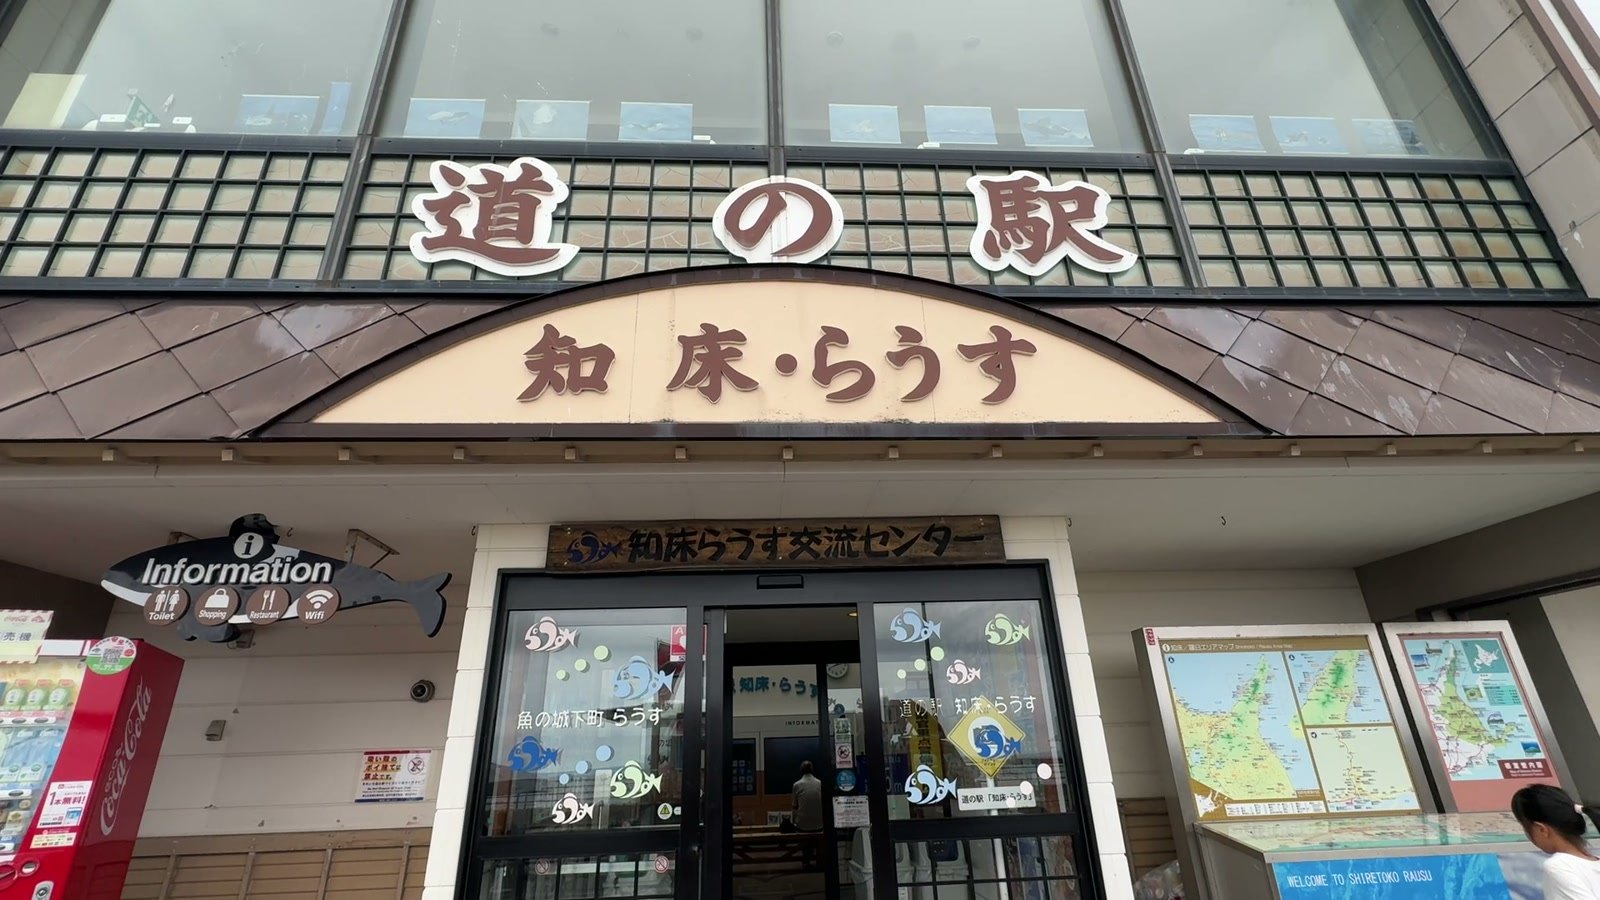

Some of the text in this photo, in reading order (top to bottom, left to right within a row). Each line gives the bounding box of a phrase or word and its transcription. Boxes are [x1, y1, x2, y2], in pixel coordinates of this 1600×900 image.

[421, 163, 1126, 265] 道の駅
[516, 323, 1038, 404] 知床・らうす
[627, 523, 985, 563] 知床らうす交流センター
[141, 557, 332, 584] Information
[149, 612, 175, 620] Toilet
[198, 609, 227, 619] Shopping
[249, 611, 280, 619] Restaurant
[305, 611, 325, 620] Wifi
[0, 631, 32, 641] 売機
[516, 707, 663, 730] 魚の城下町 らうす
[962, 794, 984, 803] 道の駅
[1287, 870, 1432, 887] WELCOME TO SHIRETOKO RAUSU
